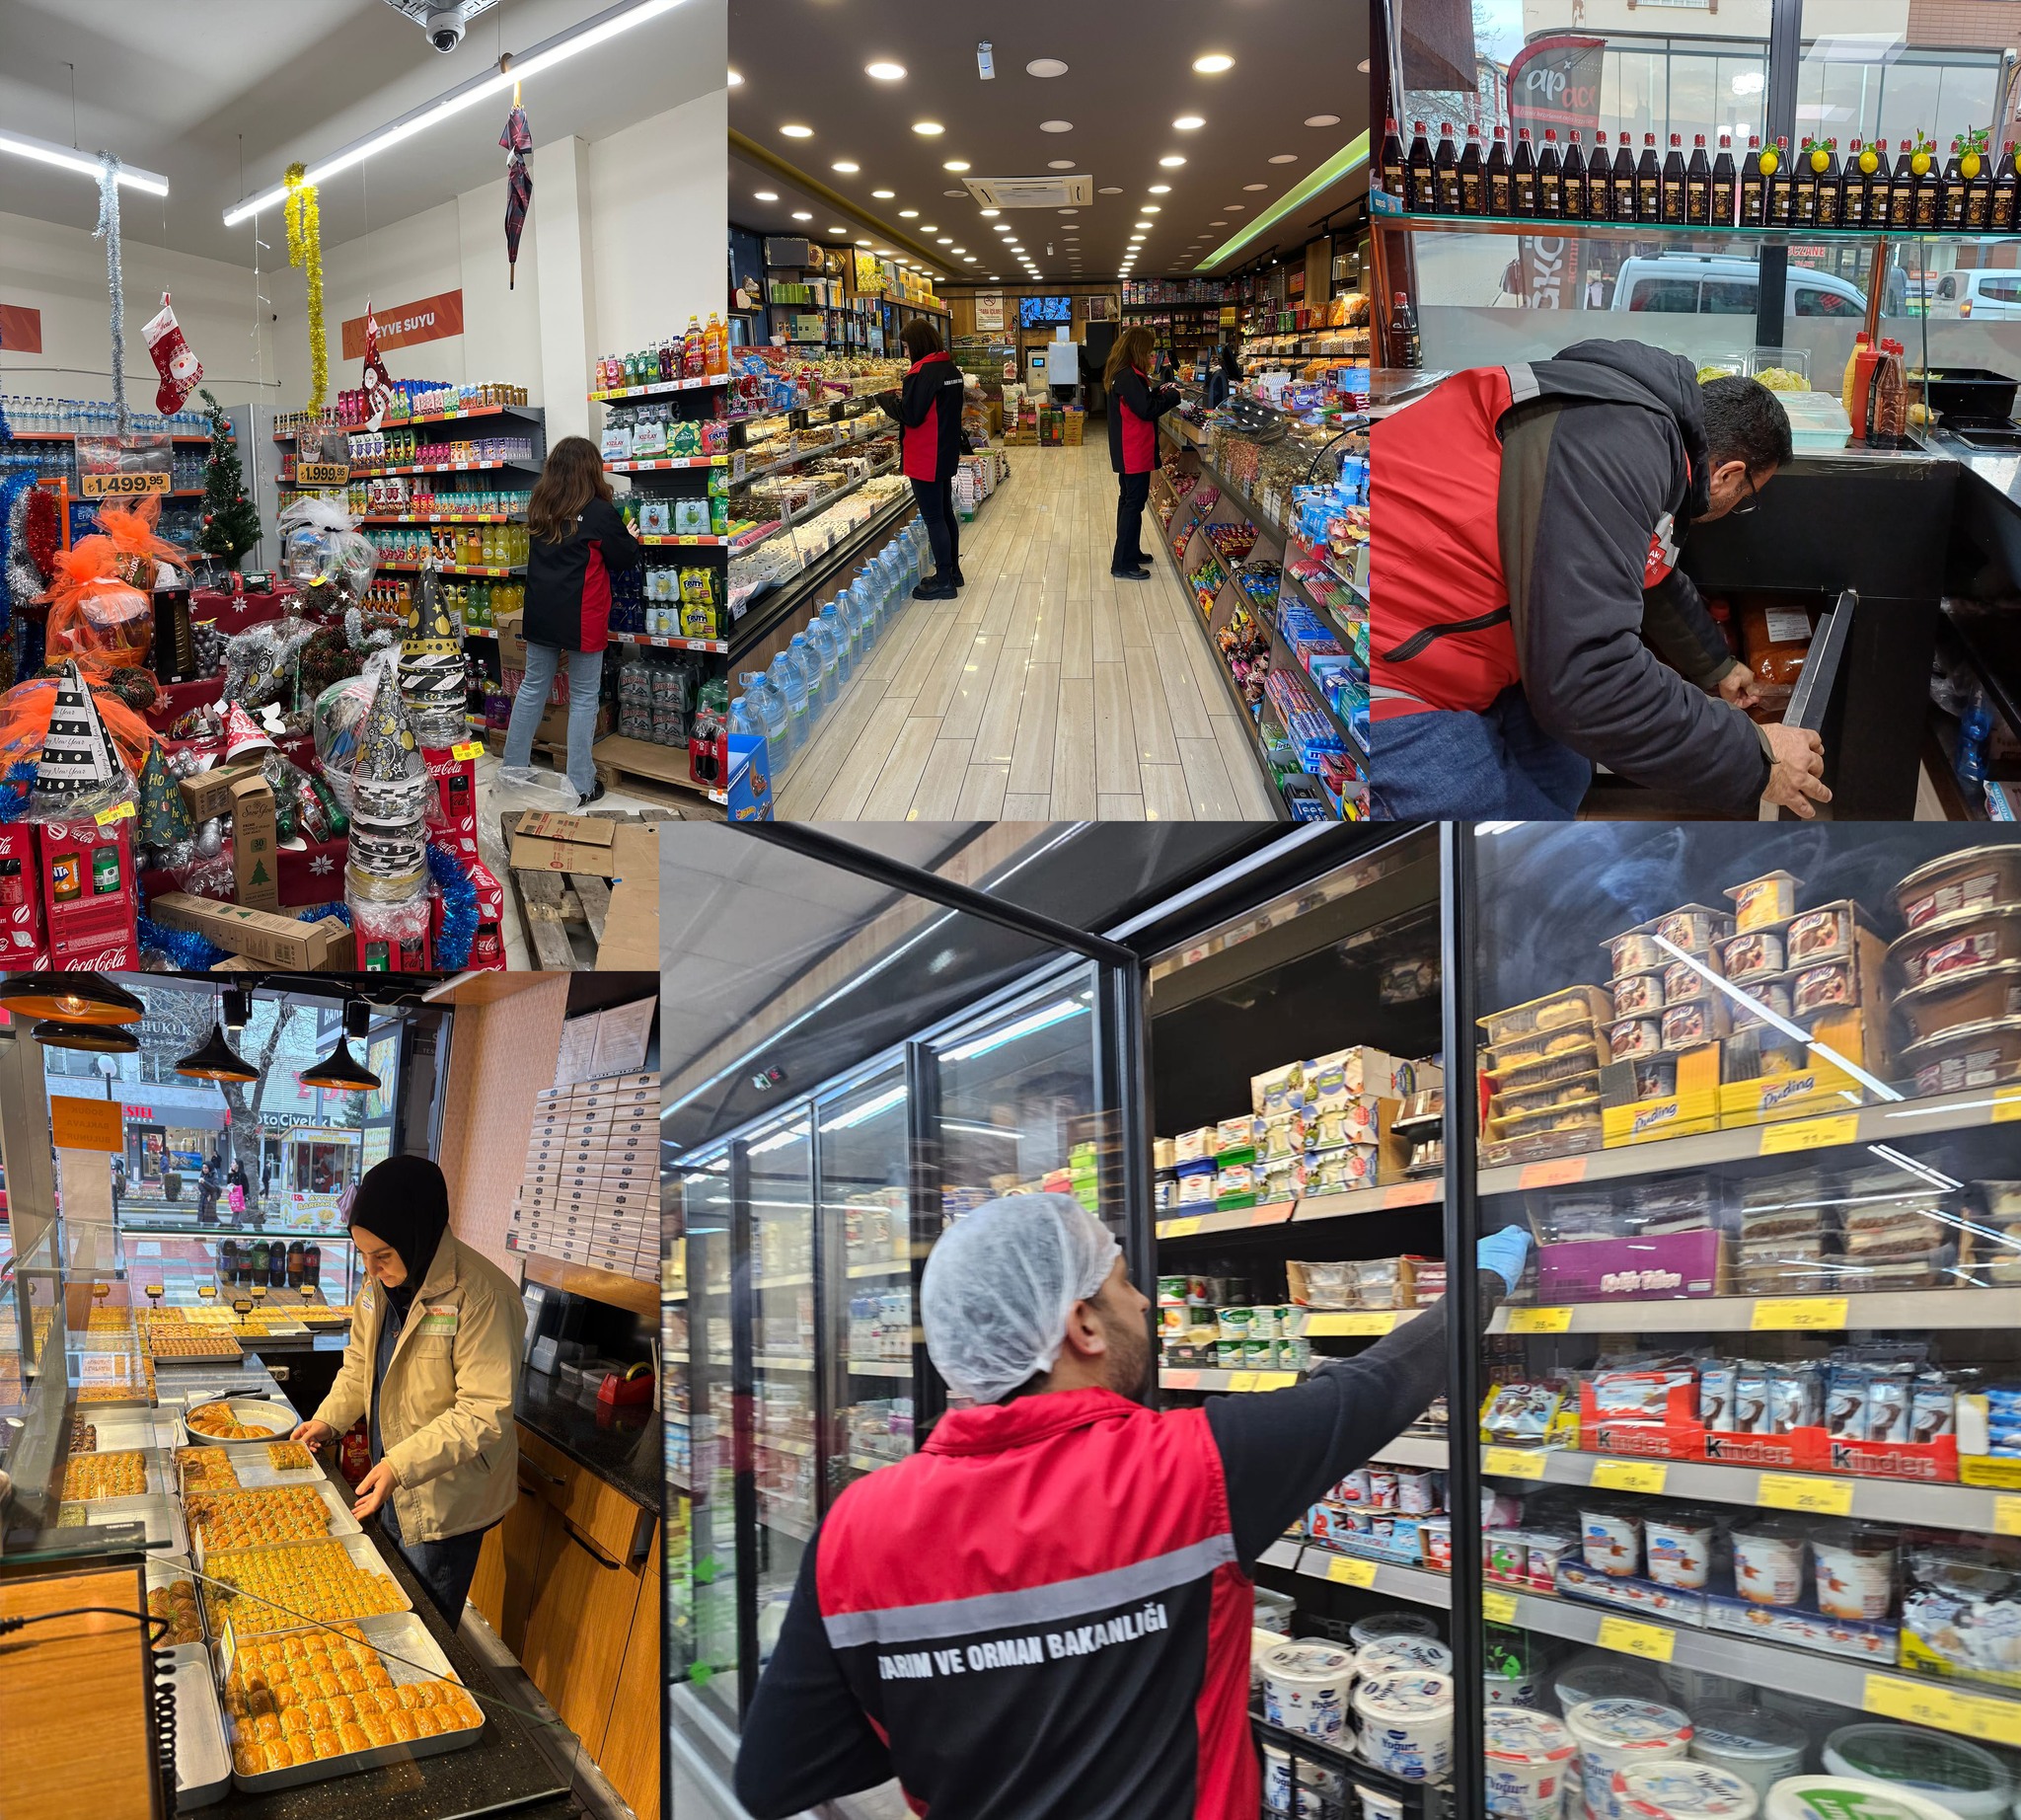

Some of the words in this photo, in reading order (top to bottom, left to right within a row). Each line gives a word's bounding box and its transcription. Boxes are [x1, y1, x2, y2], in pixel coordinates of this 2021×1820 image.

[374, 318, 402, 340] EYVE
[404, 312, 435, 332] SUYU
[122, 1104, 155, 1119] ESTEL
[935, 1648, 966, 1676] VE
[967, 1635, 1044, 1671] ORMAN
[1046, 1601, 1168, 1660] BAKANLIĞI
